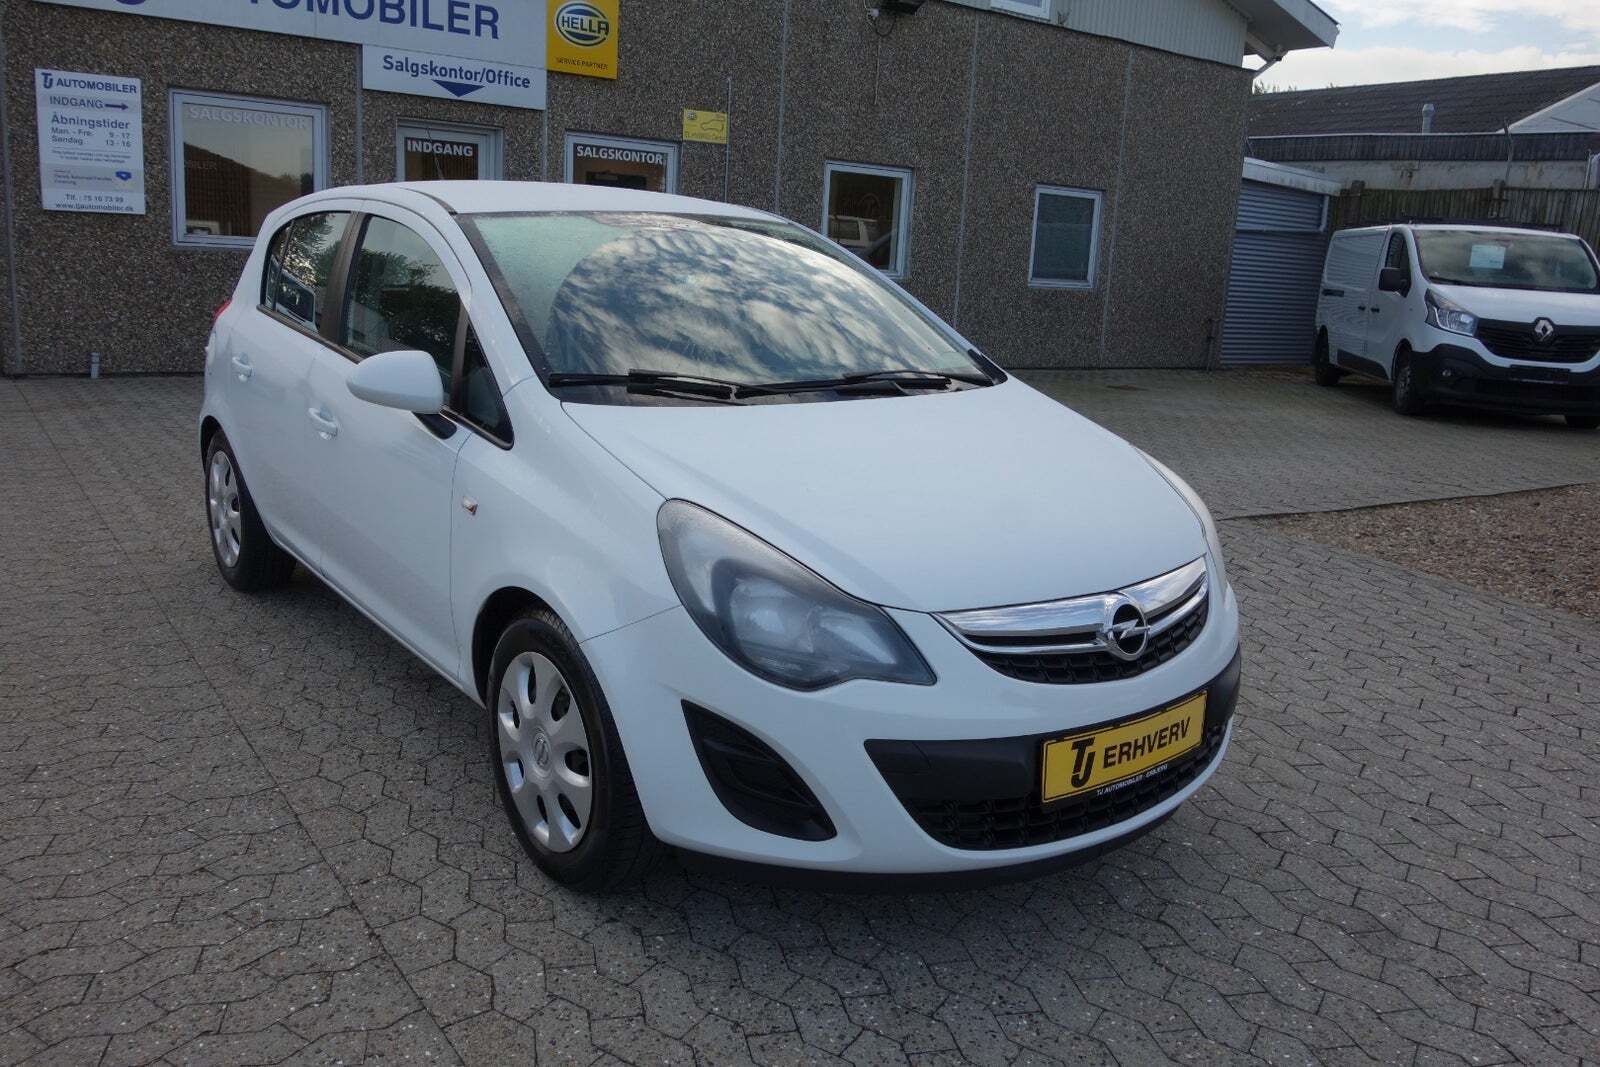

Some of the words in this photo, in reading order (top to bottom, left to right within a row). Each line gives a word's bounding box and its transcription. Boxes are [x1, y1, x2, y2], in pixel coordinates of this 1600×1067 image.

[561, 16, 609, 35] HELLA
[383, 54, 531, 89] Salgskontor/Office
[56, 77, 137, 94] AUTOMOBILER
[50, 95, 104, 109] INDGANG
[51, 111, 130, 130] Åbningstider
[188, 105, 308, 129] SALGSKONTOR
[407, 139, 473, 157] INDGANG
[576, 145, 664, 166] SALGSKONTOR
[1071, 736, 1096, 788] TJ
[1103, 716, 1191, 769] ERHVERV
[1104, 773, 1144, 795] AUTOMOBILER
